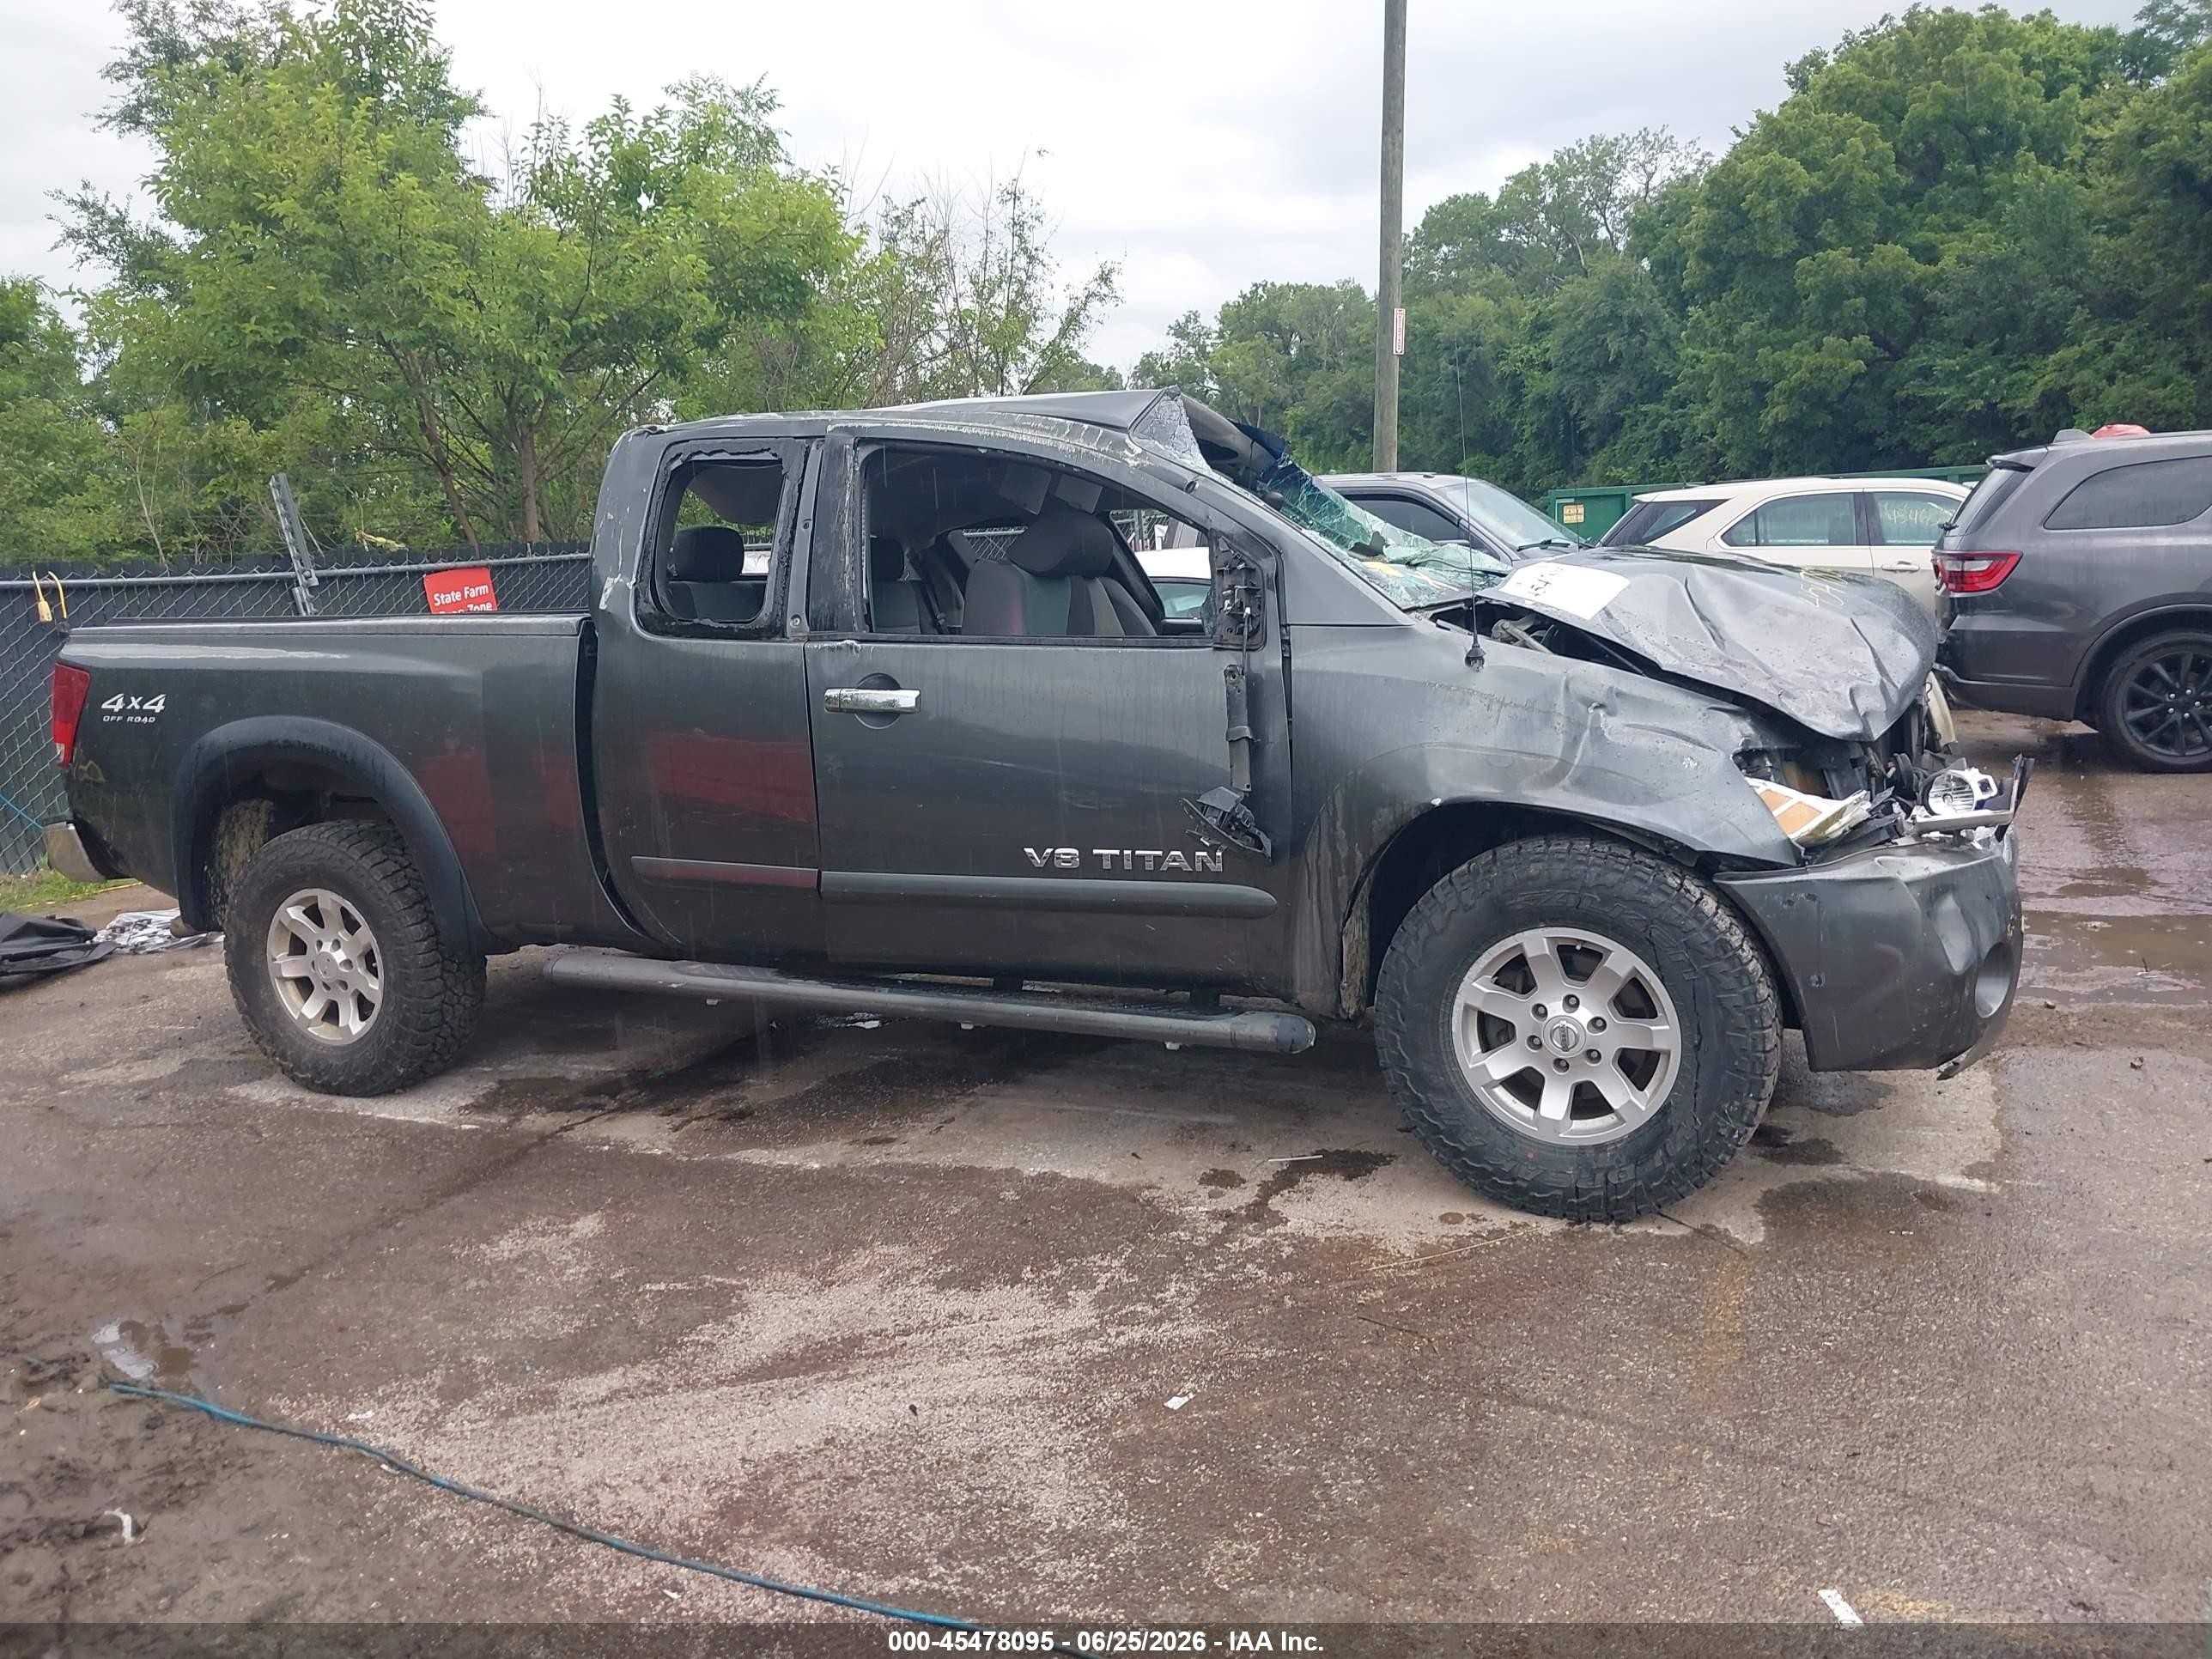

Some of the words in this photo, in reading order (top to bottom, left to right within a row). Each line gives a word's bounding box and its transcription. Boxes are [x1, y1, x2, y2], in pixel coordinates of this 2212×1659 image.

[434, 591, 462, 606] State
[464, 585, 489, 599] Farm
[126, 715, 156, 724] ROAD
[1024, 848, 1080, 869] V8
[1092, 848, 1224, 872] TITAN
